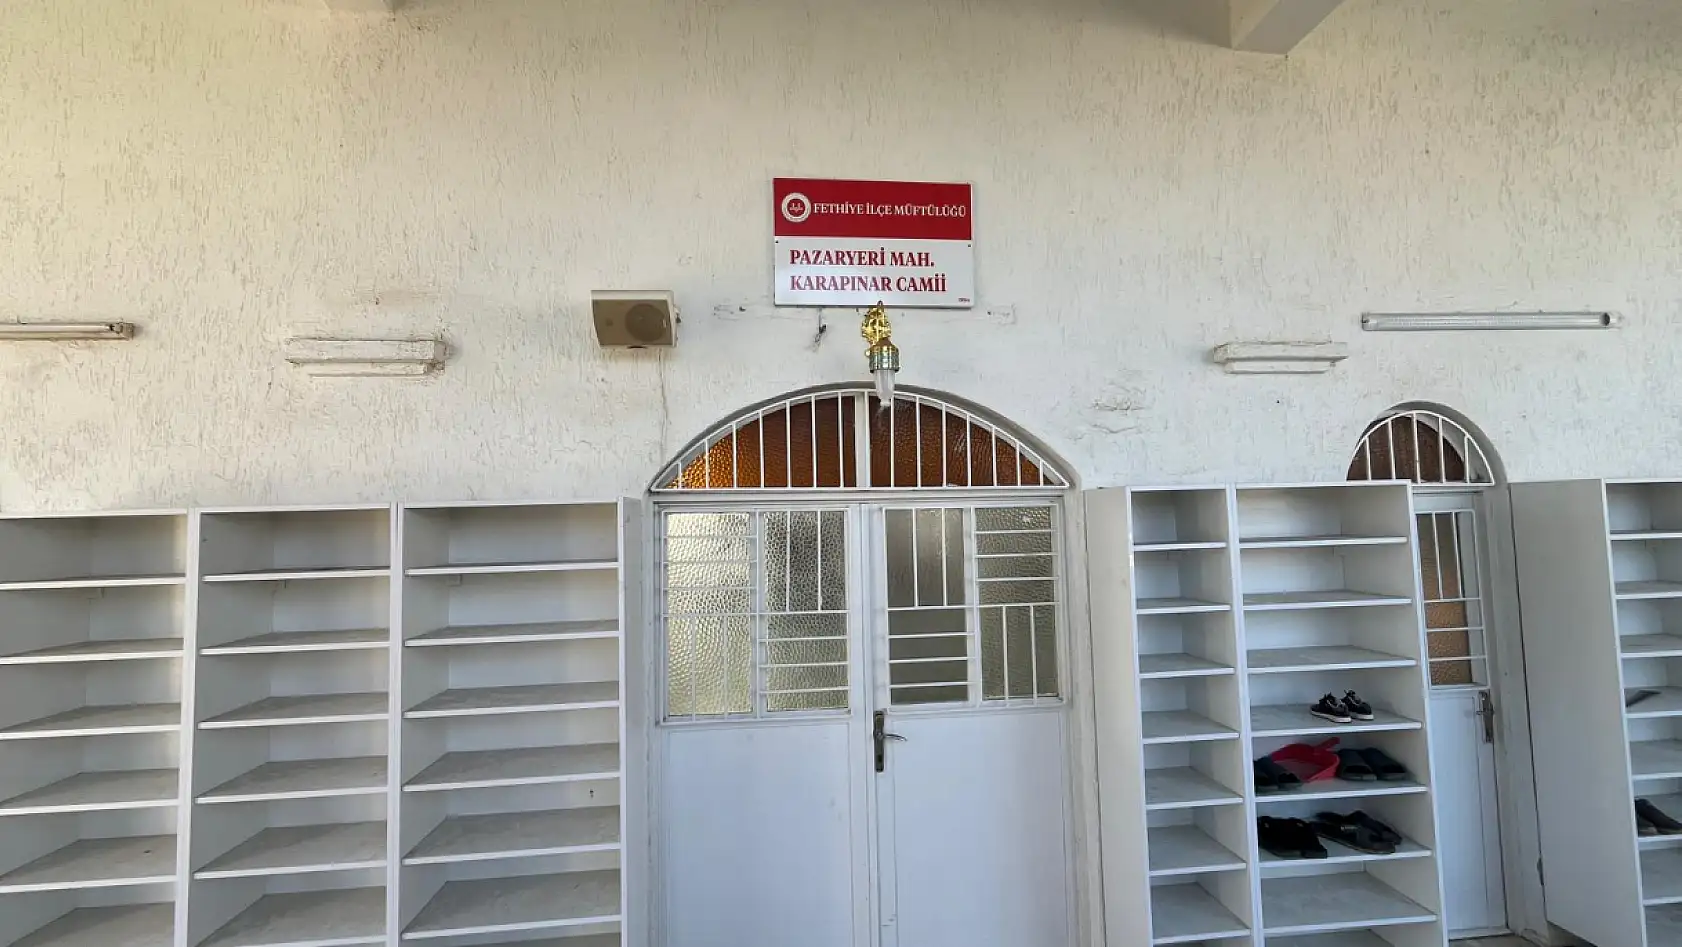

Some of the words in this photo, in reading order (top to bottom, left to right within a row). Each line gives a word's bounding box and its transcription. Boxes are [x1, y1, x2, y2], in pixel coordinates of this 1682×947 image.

[814, 202, 864, 216] FETHİYE
[865, 202, 892, 217] İLÇE
[894, 203, 967, 218] MÜFTÜLÜĞÜ
[790, 247, 885, 266] PAZARYERİ
[890, 252, 935, 267] MAH.
[790, 275, 893, 291] KARAPINAR
[896, 273, 947, 292] CAMİİ
